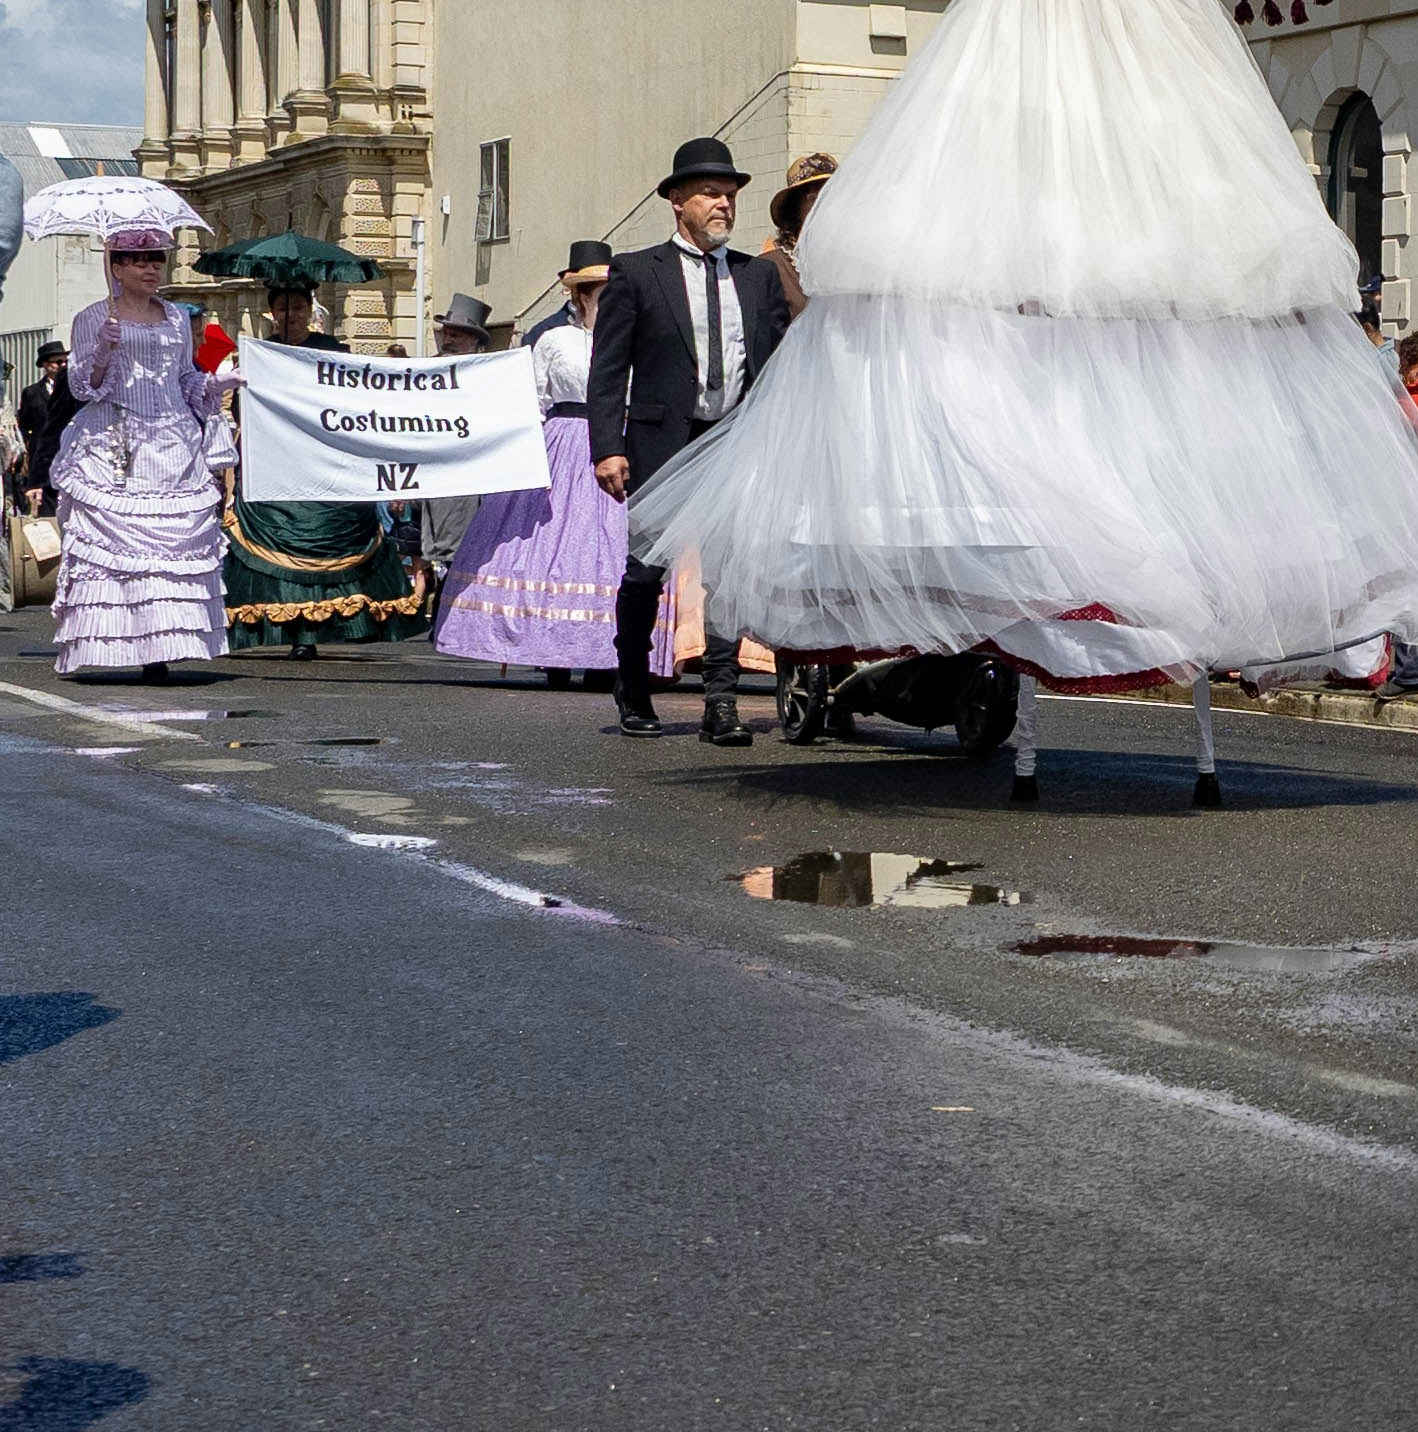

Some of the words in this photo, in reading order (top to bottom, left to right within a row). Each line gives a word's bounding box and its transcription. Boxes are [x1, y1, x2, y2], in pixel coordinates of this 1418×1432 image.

[317, 361, 460, 391] Historical
[320, 408, 470, 438] Costuming
[376, 463, 420, 491] NZ
